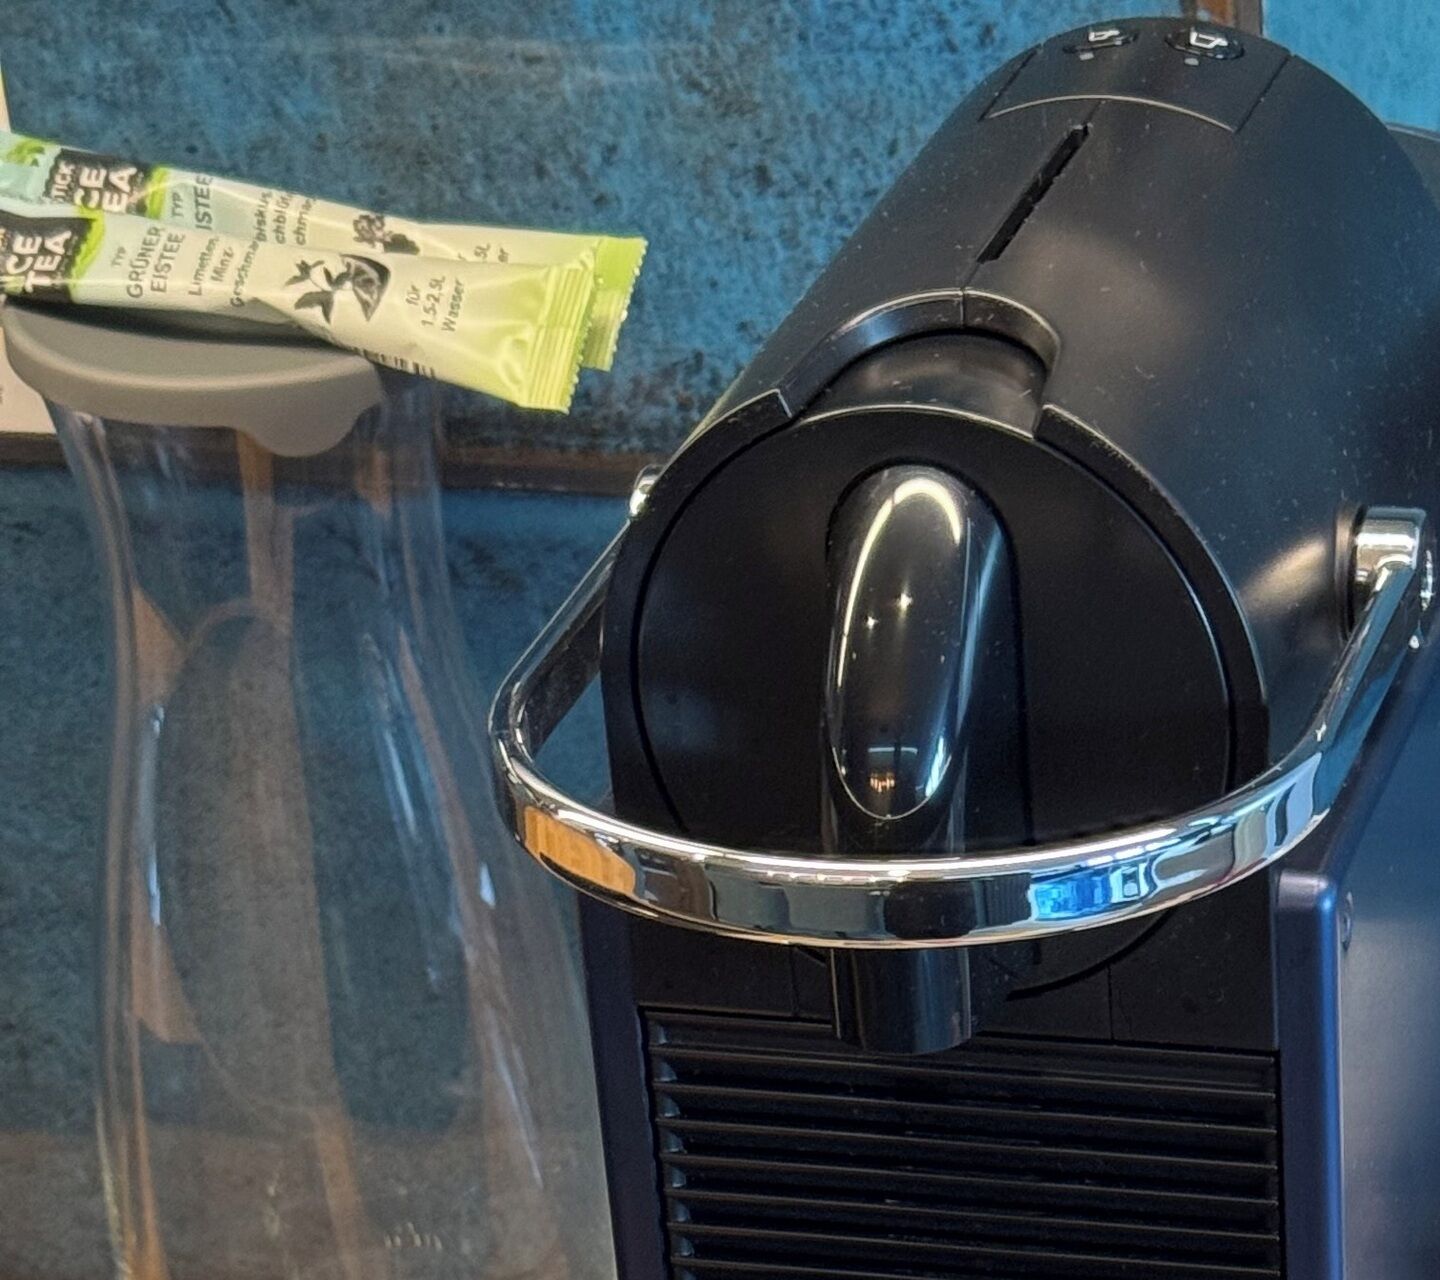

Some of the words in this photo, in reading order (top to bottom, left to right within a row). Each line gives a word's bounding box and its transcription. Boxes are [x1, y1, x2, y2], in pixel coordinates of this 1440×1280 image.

[24, 231, 71, 293] TEA
[127, 227, 163, 298] GRÜNER
[151, 233, 185, 293] EISTEE
[441, 278, 464, 332] Wasser
